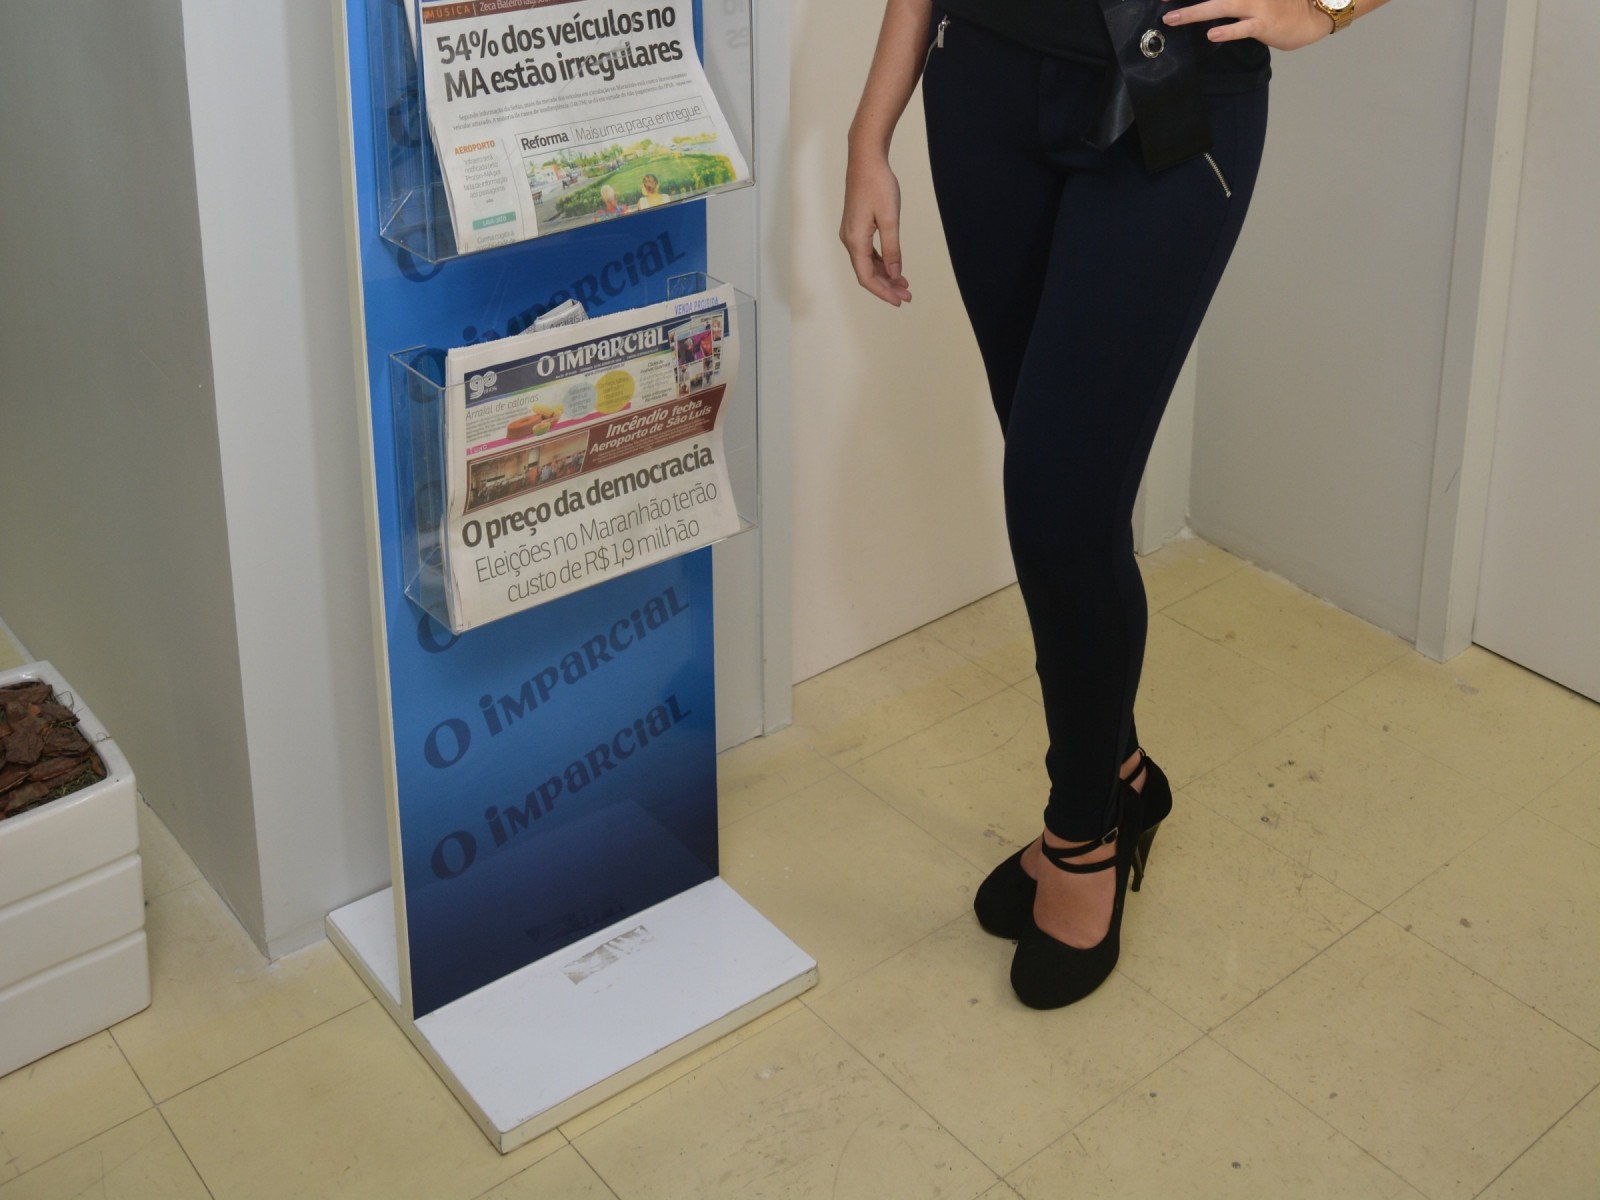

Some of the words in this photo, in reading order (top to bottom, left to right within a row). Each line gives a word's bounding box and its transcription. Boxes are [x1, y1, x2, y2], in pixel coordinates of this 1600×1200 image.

[480, 1, 496, 12] Zeca
[437, 28, 499, 65] 54%
[501, 24, 546, 54] dos
[547, 9, 644, 46] veículos
[647, 6, 676, 30] no
[444, 67, 490, 102] MA
[491, 57, 557, 93] estão
[558, 40, 683, 82] irregulares
[455, 140, 496, 155] AEROPORTO
[520, 131, 570, 151] Reforma
[575, 127, 599, 142] Mais
[600, 123, 625, 138] uma
[625, 115, 655, 134] praça
[655, 104, 702, 125] entregue
[537, 355, 554, 376] O
[466, 406, 493, 420] Arraial
[495, 402, 506, 412] de
[590, 429, 648, 454] Aeroporto
[649, 423, 663, 433] de
[666, 414, 687, 429] São
[689, 405, 712, 420] Luís
[606, 408, 668, 438] Incêndio
[672, 400, 702, 416] fecha
[462, 520, 482, 548] O
[486, 506, 551, 548] preço
[554, 490, 585, 518] da
[586, 444, 714, 504] democracia
[476, 541, 551, 583] Eleições
[554, 533, 577, 555] no
[580, 499, 671, 547] Maranhão
[673, 482, 717, 511] terão
[508, 572, 557, 602] custo
[560, 560, 582, 584] de
[584, 547, 609, 574] R$
[612, 538, 636, 567] 1,9
[638, 519, 700, 555] milhão
[424, 717, 472, 769] O
[431, 829, 477, 880] O
